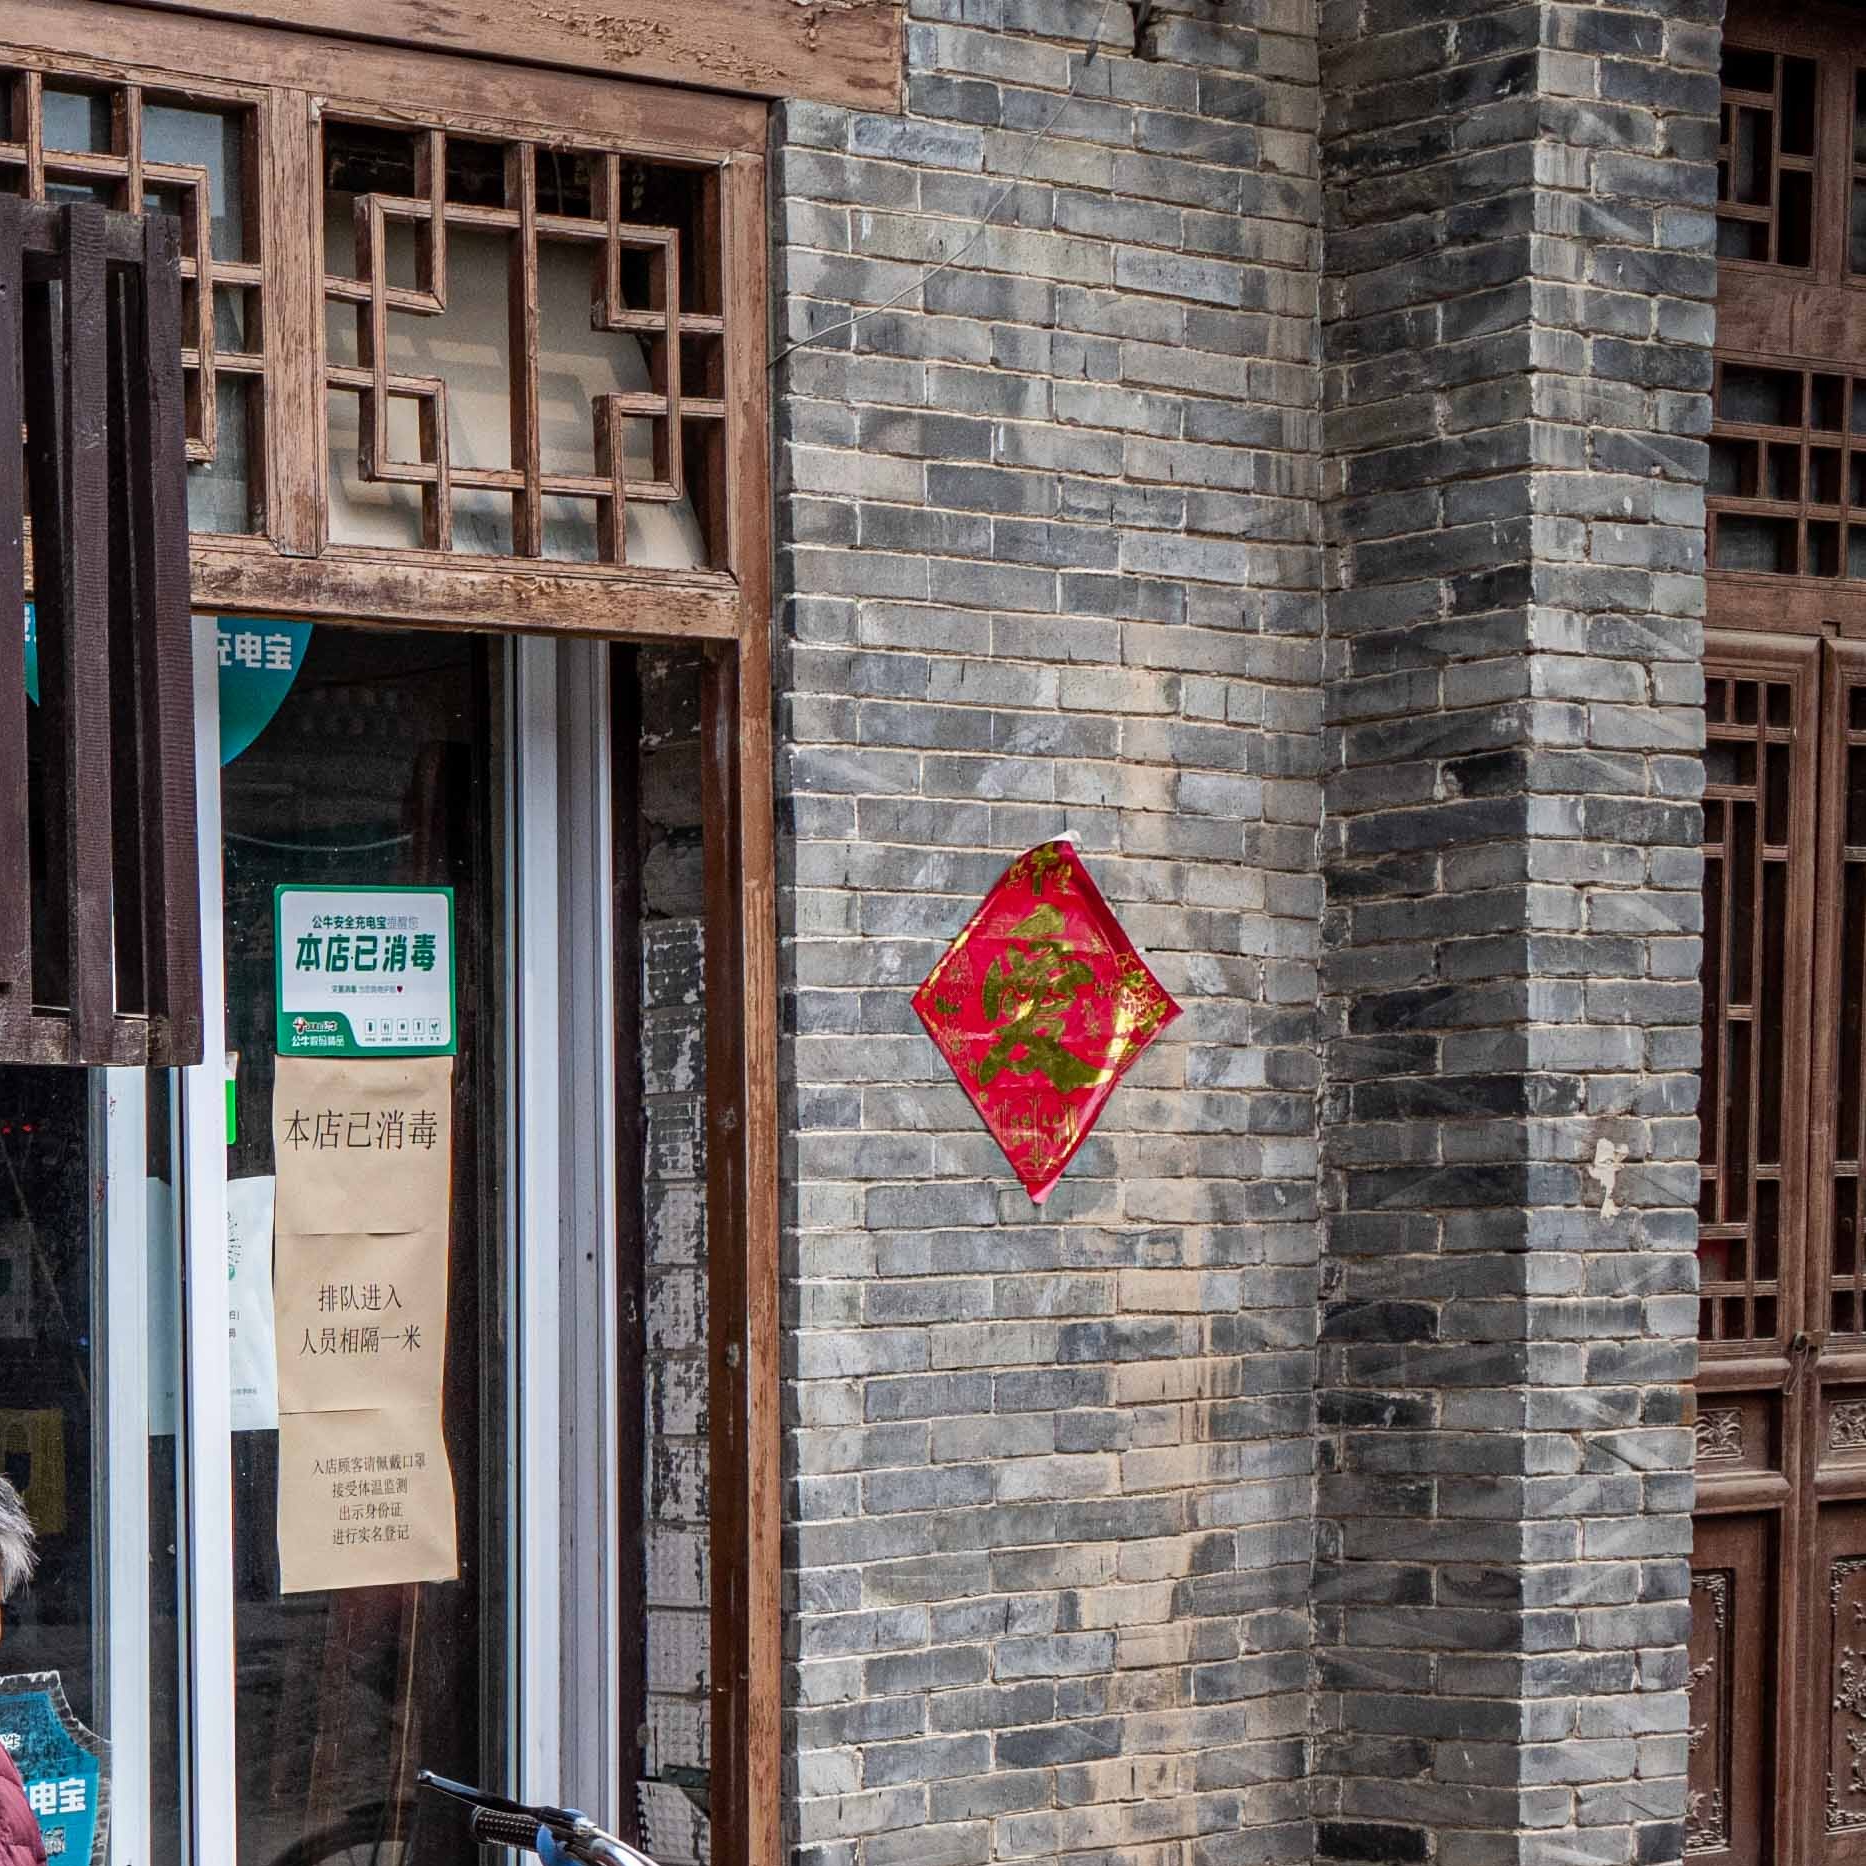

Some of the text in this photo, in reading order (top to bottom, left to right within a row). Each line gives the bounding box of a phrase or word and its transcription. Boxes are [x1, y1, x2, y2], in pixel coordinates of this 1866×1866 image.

[295, 933, 436, 972] 本店已消毒
[282, 1109, 438, 1151] 本店已消毒
[318, 1283, 402, 1312] 排队进入
[300, 1324, 421, 1355] 人员相隔一米
[312, 1452, 426, 1475] 入店顾客请佩戴口罩
[332, 1477, 408, 1498] 接受体温监测
[339, 1502, 403, 1521] 出示身份证
[332, 1524, 410, 1545] 进行实名登记
[22, 1778, 87, 1815] 电宝
